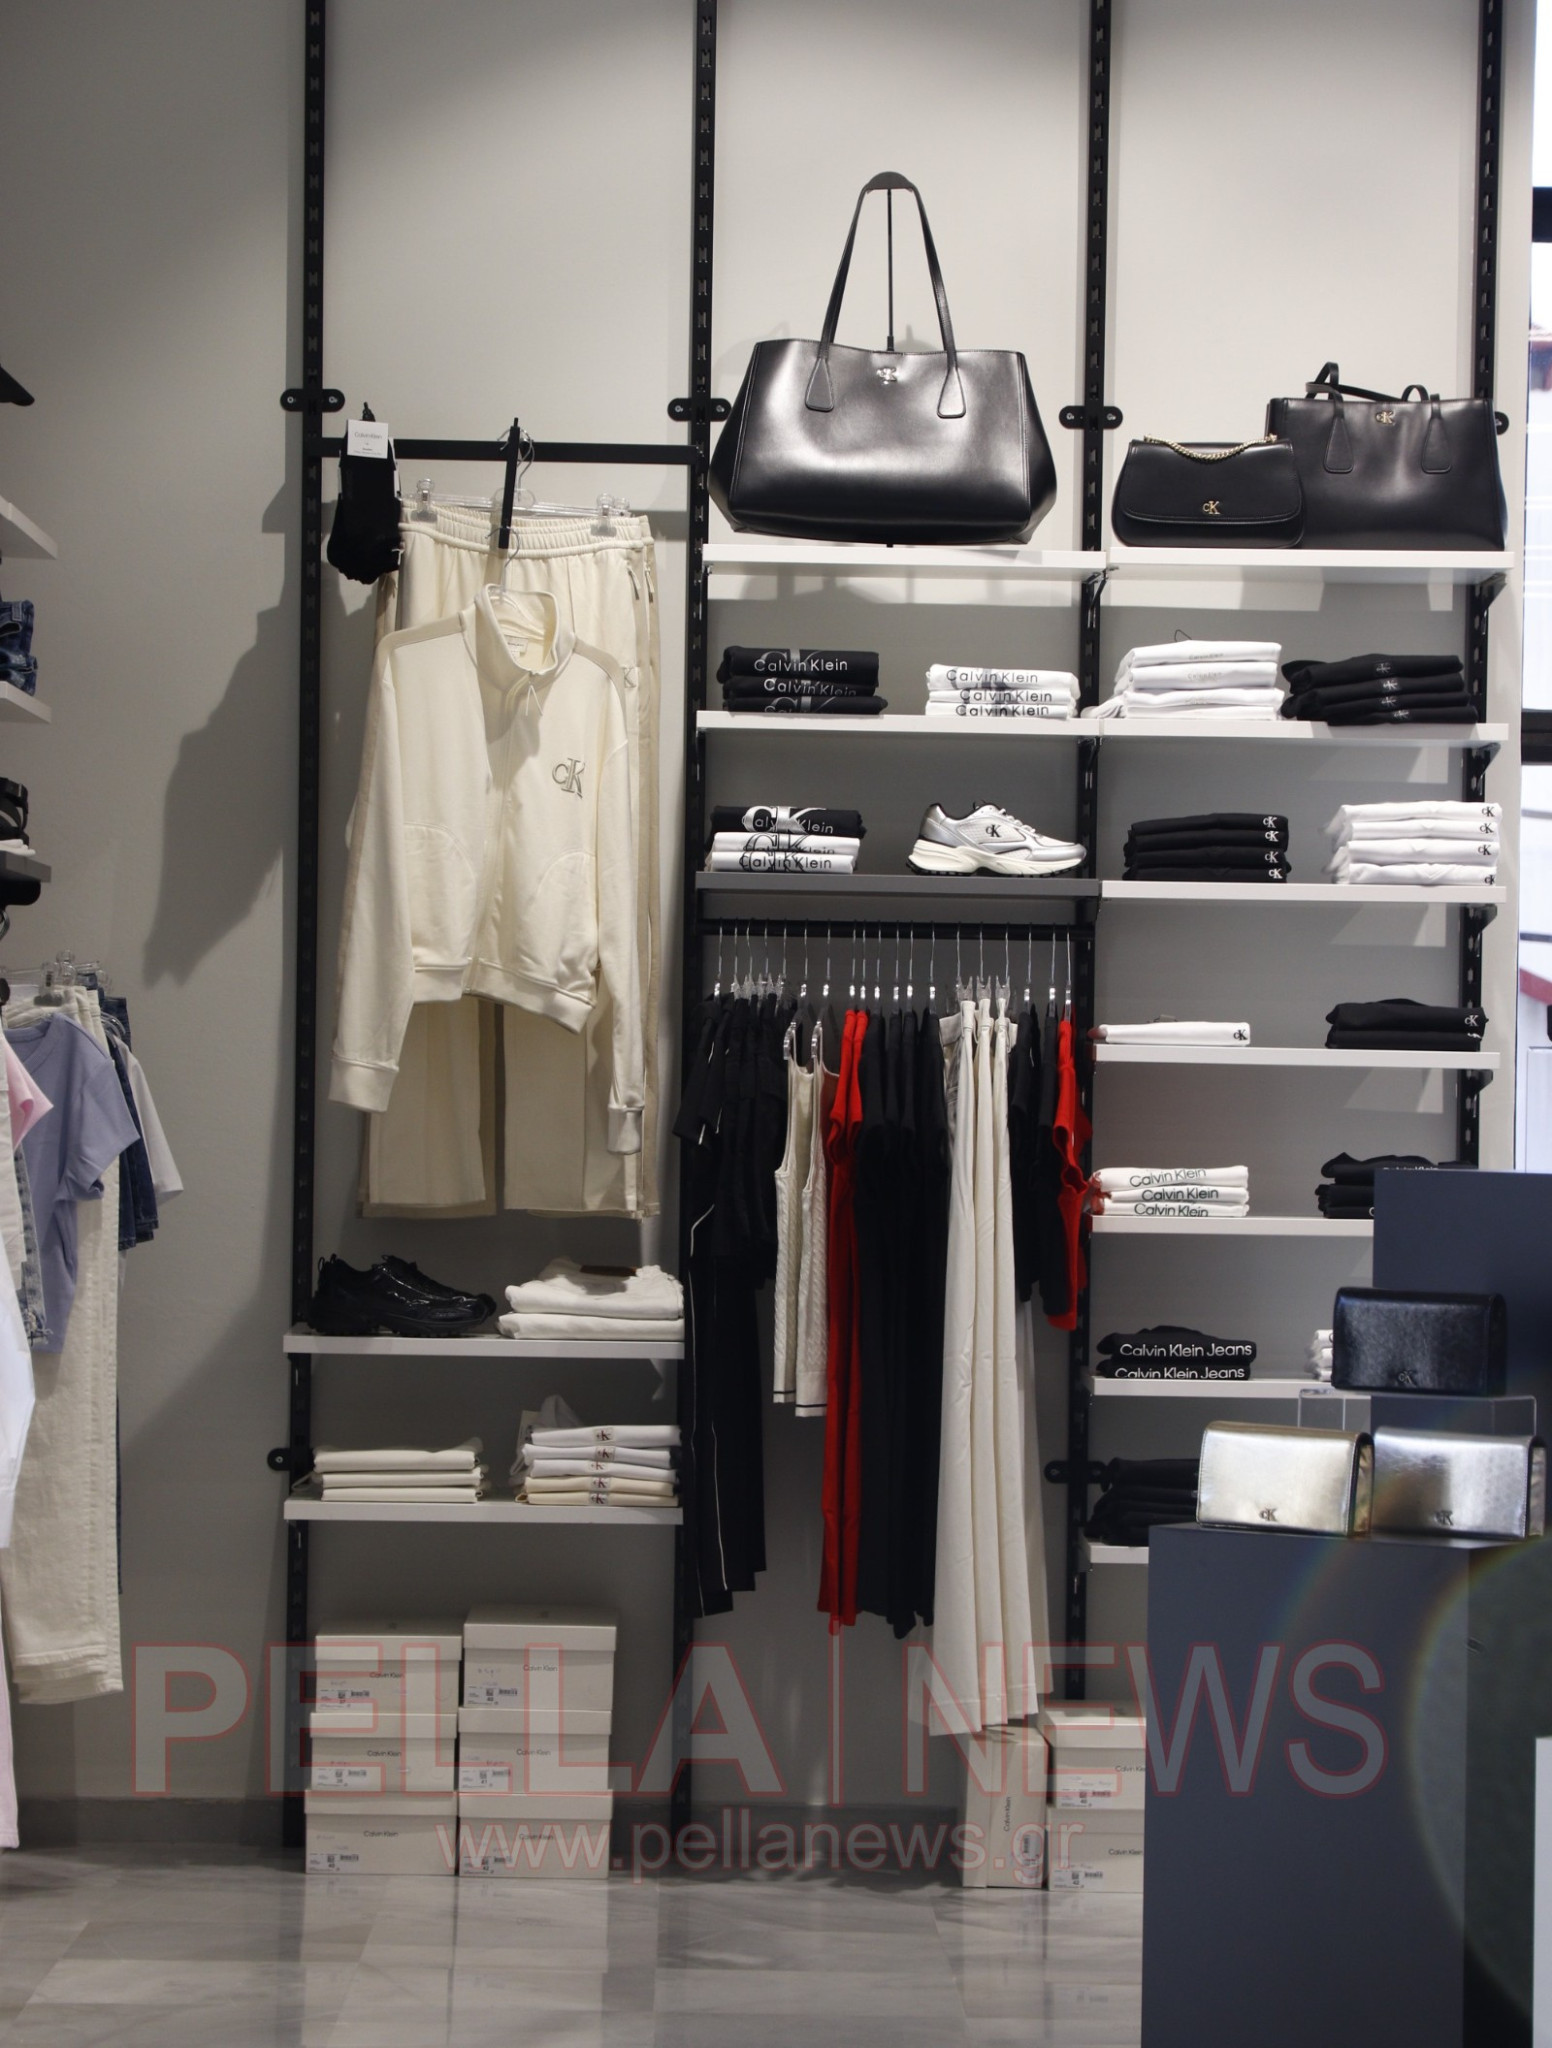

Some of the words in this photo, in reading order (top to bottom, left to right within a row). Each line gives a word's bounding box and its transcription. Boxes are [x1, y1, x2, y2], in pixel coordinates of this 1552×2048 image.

[754, 658, 807, 672] Calvin
[810, 658, 848, 671] Klein
[946, 669, 998, 682] Calvin
[1001, 672, 1038, 684] Klein
[764, 678, 816, 694] Calvin
[960, 689, 1011, 701] Calvin
[1016, 690, 1052, 702] Klein
[956, 704, 1008, 717] Calvin
[1012, 704, 1049, 717] Klein
[794, 857, 832, 870] Klein
[1130, 1171, 1173, 1187] Calvin
[1175, 1168, 1206, 1180] Klein
[1141, 1188, 1184, 1201] Calvin
[1186, 1188, 1218, 1200] Klein
[1134, 1203, 1176, 1216] Calvin
[1178, 1205, 1208, 1217] Klein
[1120, 1343, 1166, 1356] Calvin
[1169, 1343, 1204, 1357] Klein
[1206, 1343, 1252, 1357] Jeans
[1115, 1367, 1161, 1378] Calvin
[1164, 1367, 1198, 1379] Klein
[1200, 1367, 1245, 1379] Jeans
